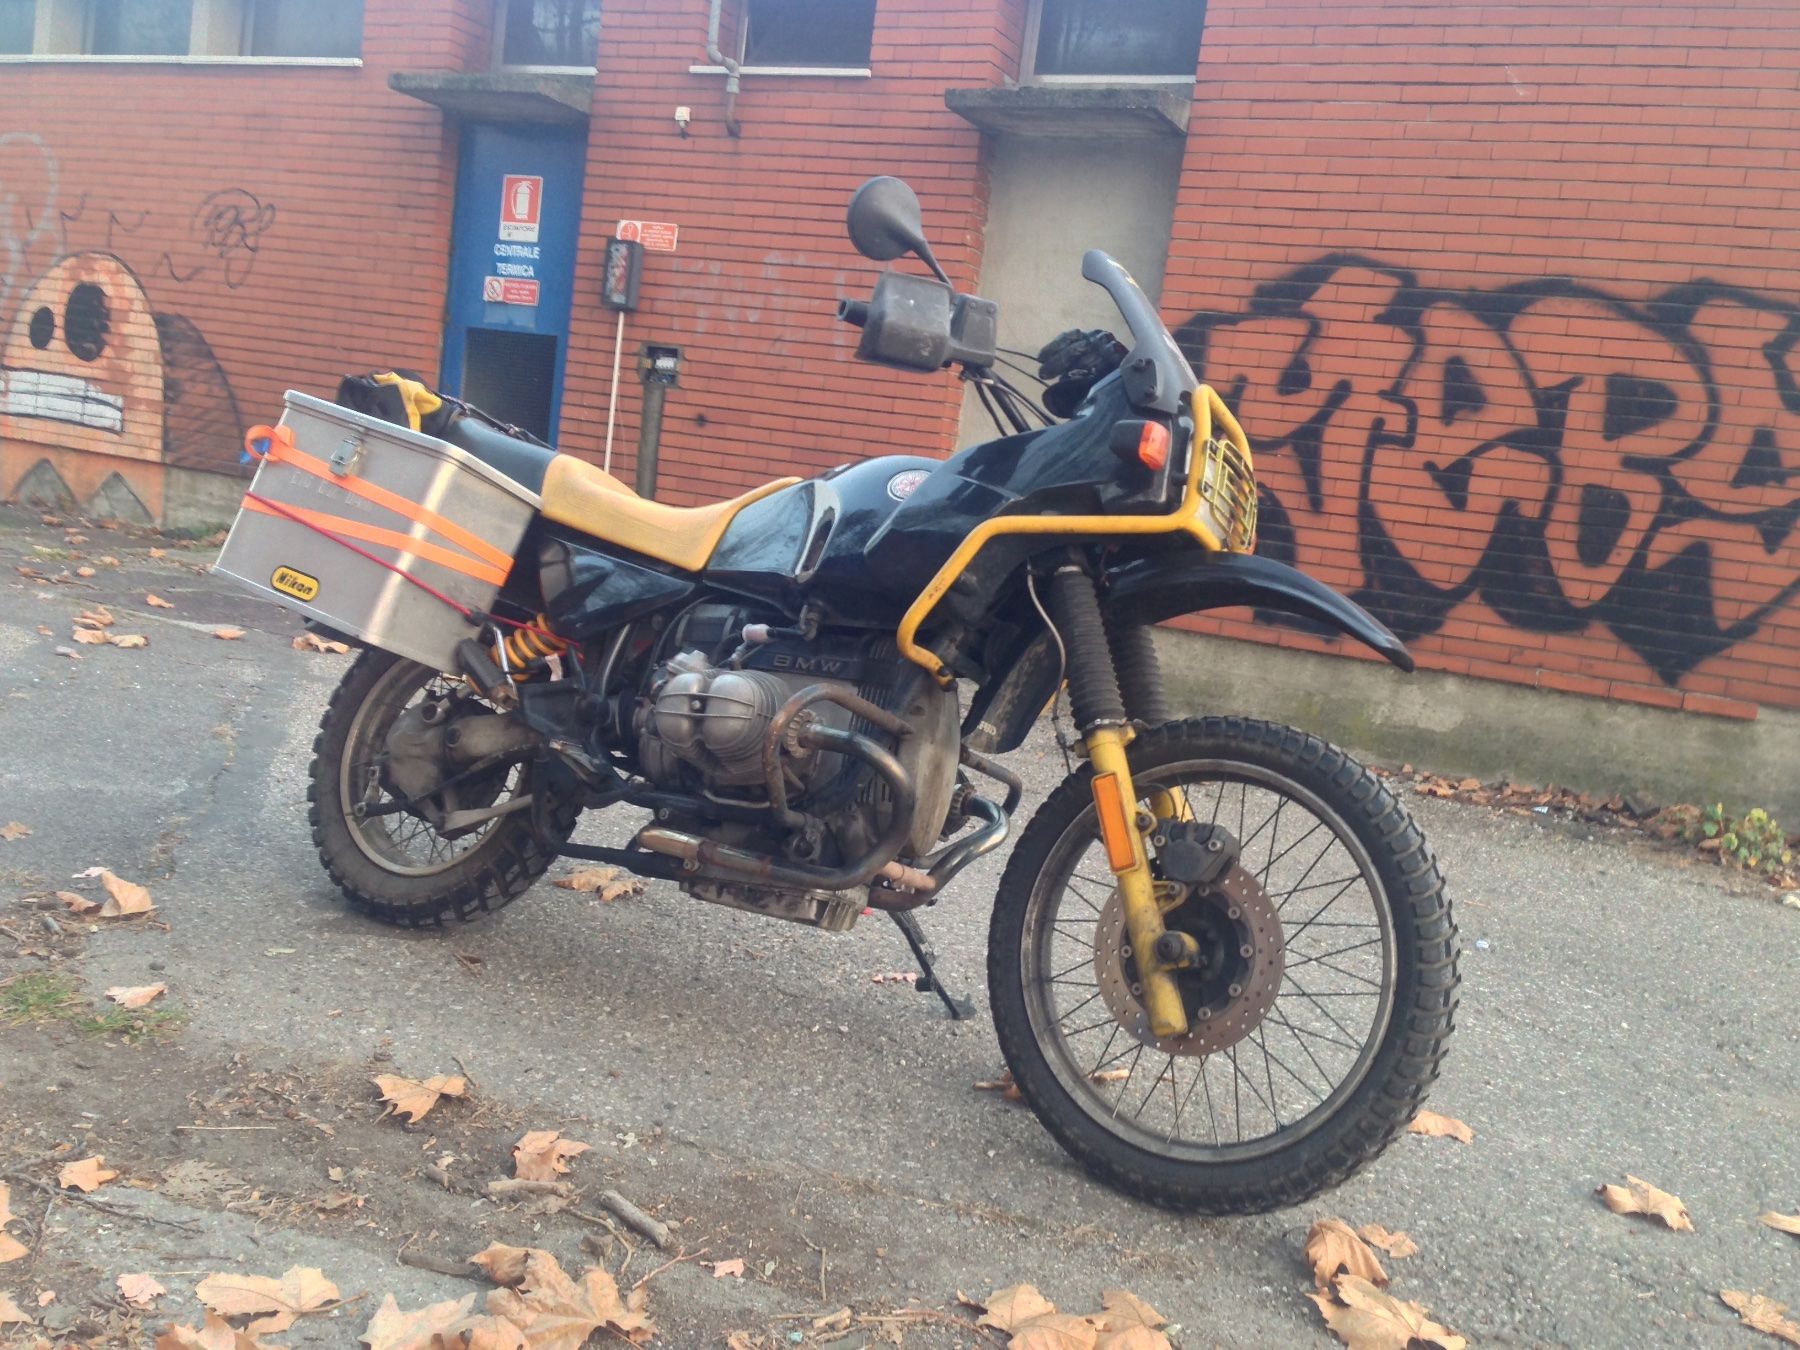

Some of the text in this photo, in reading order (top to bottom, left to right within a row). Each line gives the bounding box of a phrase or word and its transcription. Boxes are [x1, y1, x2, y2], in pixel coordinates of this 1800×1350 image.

[493, 244, 541, 259] CENTRALE
[496, 262, 535, 277] TERMICA
[275, 572, 313, 595] Nikon
[773, 654, 840, 672] BMW
